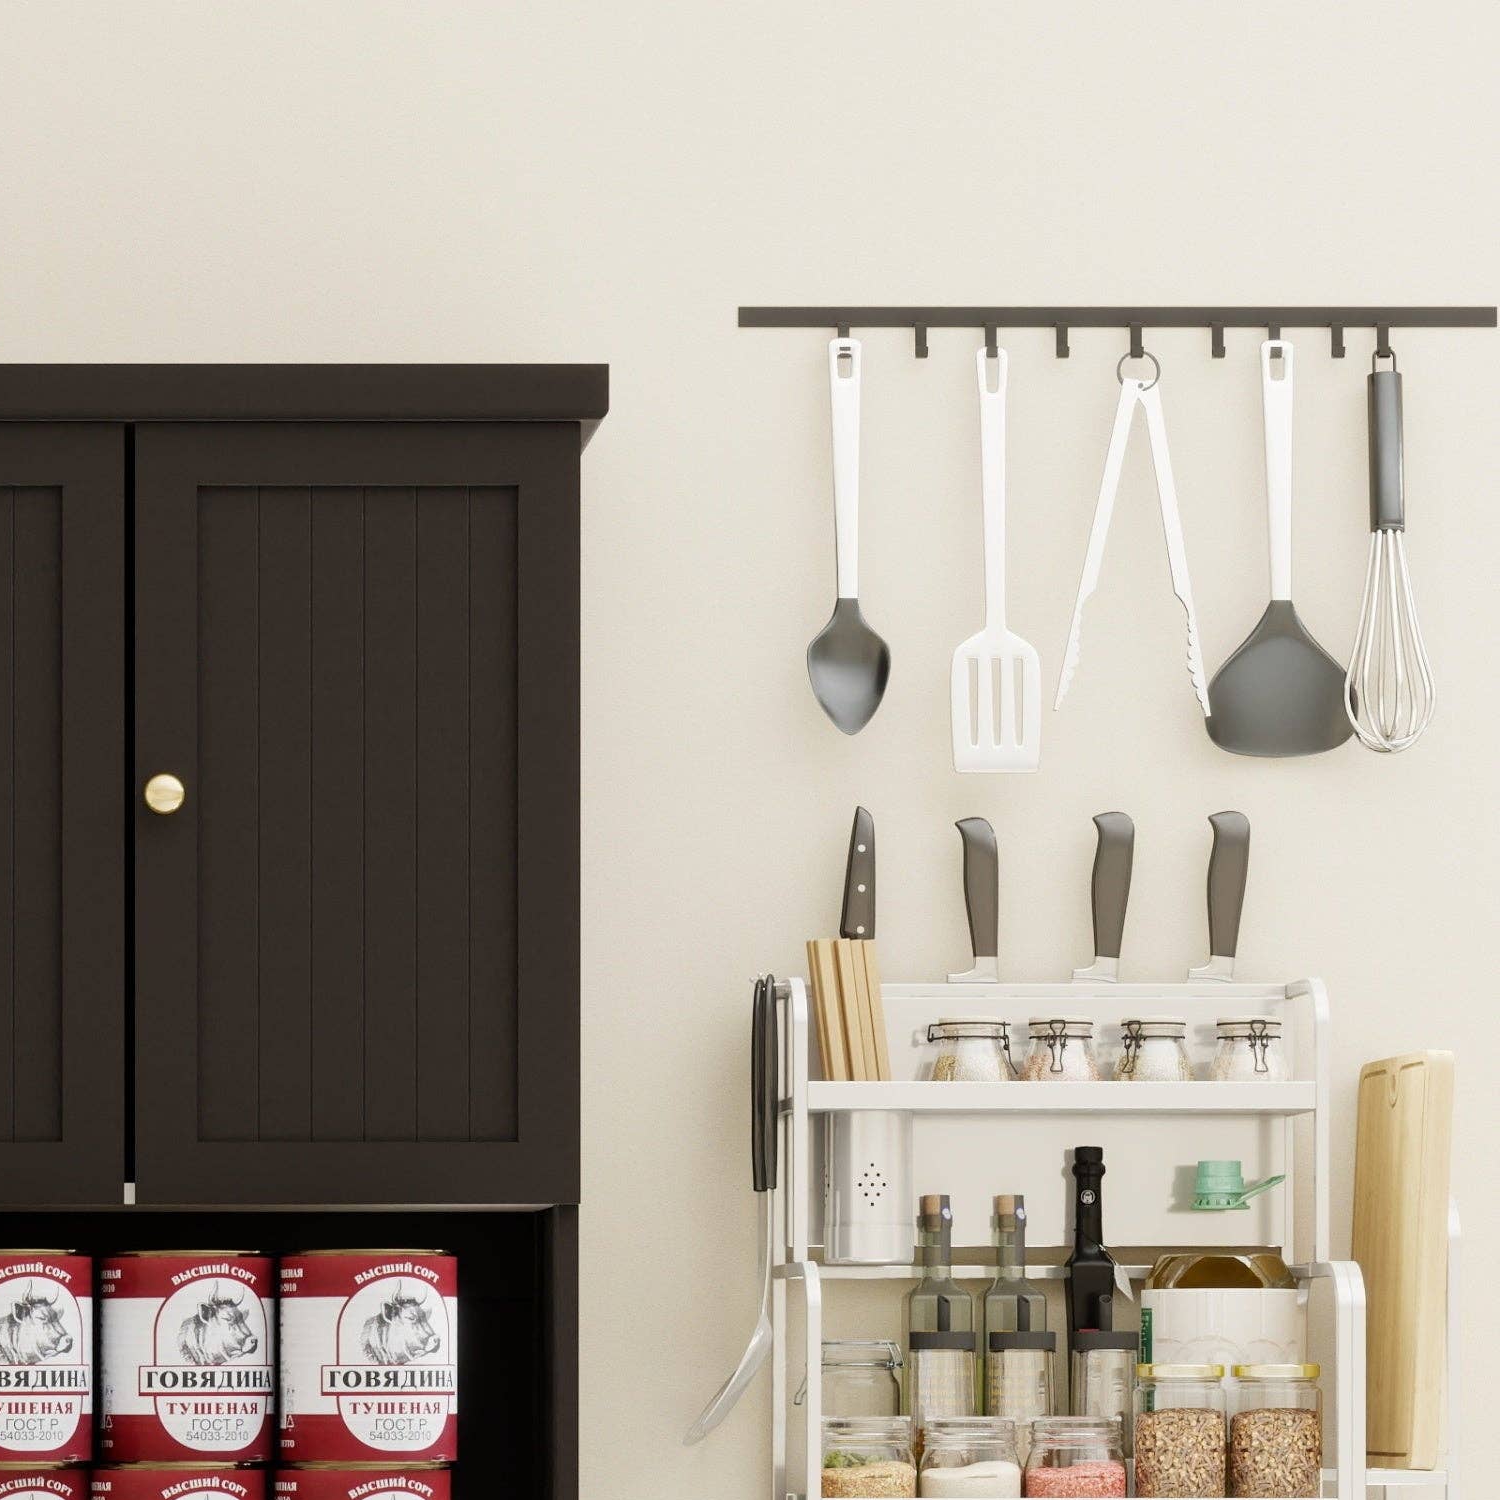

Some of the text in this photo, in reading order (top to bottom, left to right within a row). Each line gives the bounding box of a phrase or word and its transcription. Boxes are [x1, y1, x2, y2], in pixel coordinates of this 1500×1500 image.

[45, 1265, 73, 1284] СОРТ
[171, 1263, 258, 1286] ВЫСШИЙ СОРТ
[354, 1262, 440, 1285] ВЫСШИЙ СОРТ
[146, 1370, 272, 1391] ГОВЯДИНА
[329, 1370, 453, 1391] ГОВЯДИНА
[166, 1402, 259, 1415] ТУШЕНАЯ
[349, 1402, 442, 1415] ТУШЕНАЯ
[5, 1418, 60, 1431] ГОСТ Р
[192, 1418, 245, 1431] ГОСТ Р
[375, 1418, 428, 1431] ГОСТ Р
[0, 1430, 64, 1441] 54033-2010
[186, 1430, 249, 1441] 54033-2010
[369, 1430, 432, 1441] 54033-2010
[46, 1479, 73, 1497] СОРТ
[161, 1476, 248, 1500] ВЫСШИЙ СОРТ
[348, 1476, 434, 1500] ВЫСШИЙ СОРТ
